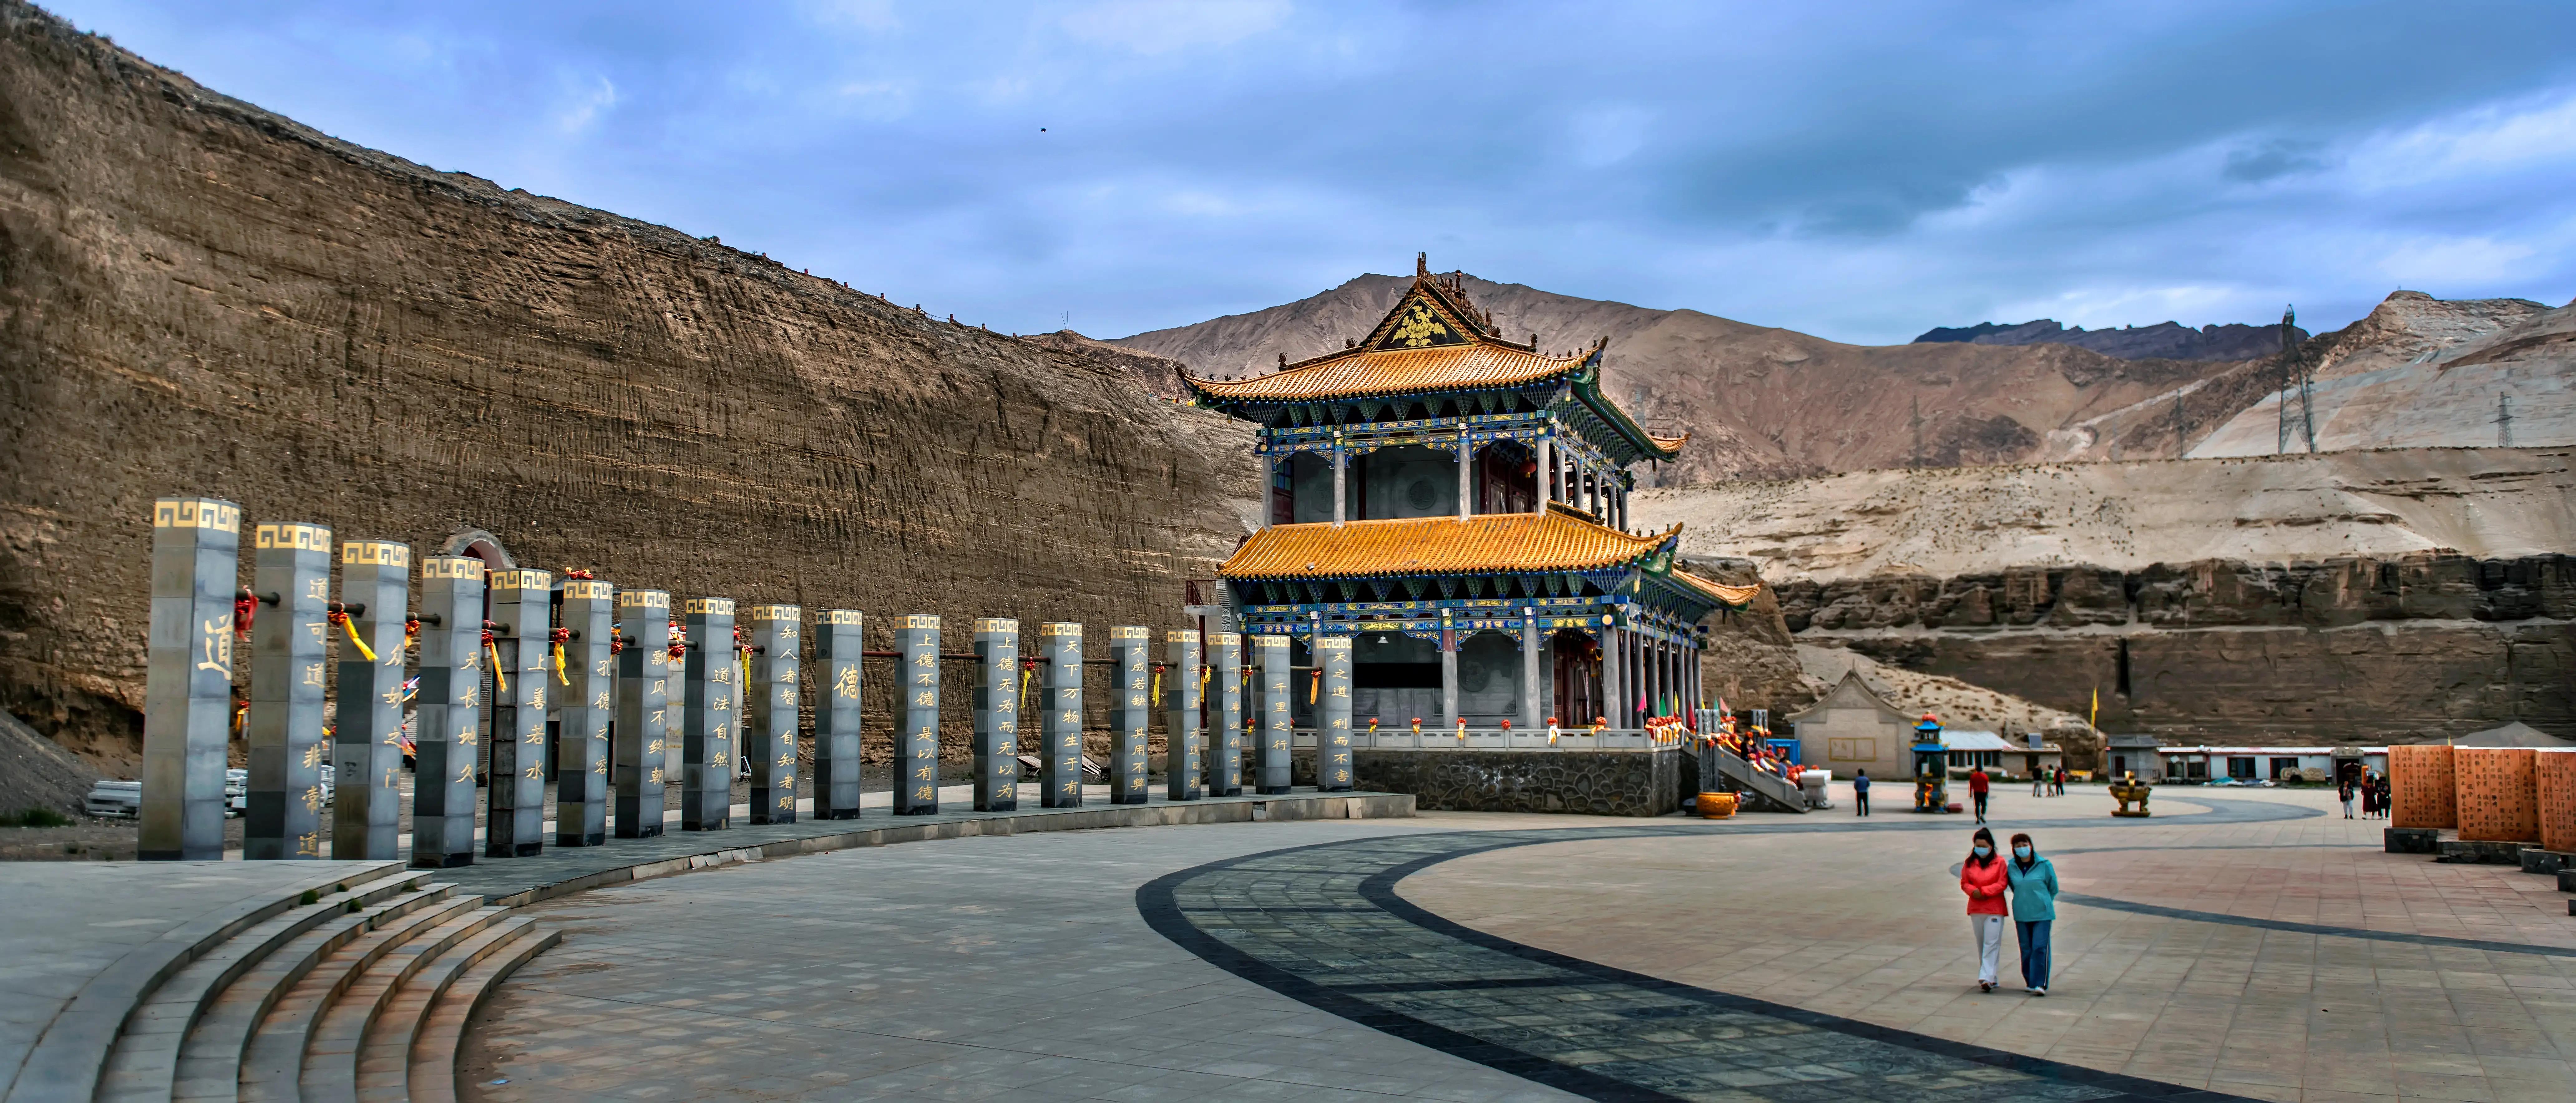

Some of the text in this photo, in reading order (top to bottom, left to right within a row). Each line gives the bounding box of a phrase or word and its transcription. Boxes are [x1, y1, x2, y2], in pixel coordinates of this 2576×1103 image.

[198, 612, 233, 680] 道
[833, 663, 860, 699] 德
[296, 578, 328, 857] 道可道 非常道
[383, 644, 405, 790] 众妙之门
[456, 651, 479, 783] 天长地久
[524, 654, 546, 780] 上善若水
[594, 659, 610, 774] 孔德之容
[649, 650, 667, 785] 飘风不终朝
[712, 668, 731, 768] 道法自然
[778, 625, 797, 810] 知人者智 自知者明
[914, 633, 935, 800] 上德不德 是以有德
[996, 636, 1015, 798] 上德无为而无以为
[1062, 640, 1080, 794] 天下万物生于有
[1130, 643, 1145, 790] 大成若缺 其用不弊
[1189, 647, 1200, 789] 为学日益 为道日损
[1229, 649, 1241, 785] 天下难事必作于易
[1272, 682, 1288, 751] 千里之行
[1332, 651, 1348, 782] 天之道 利而不害
